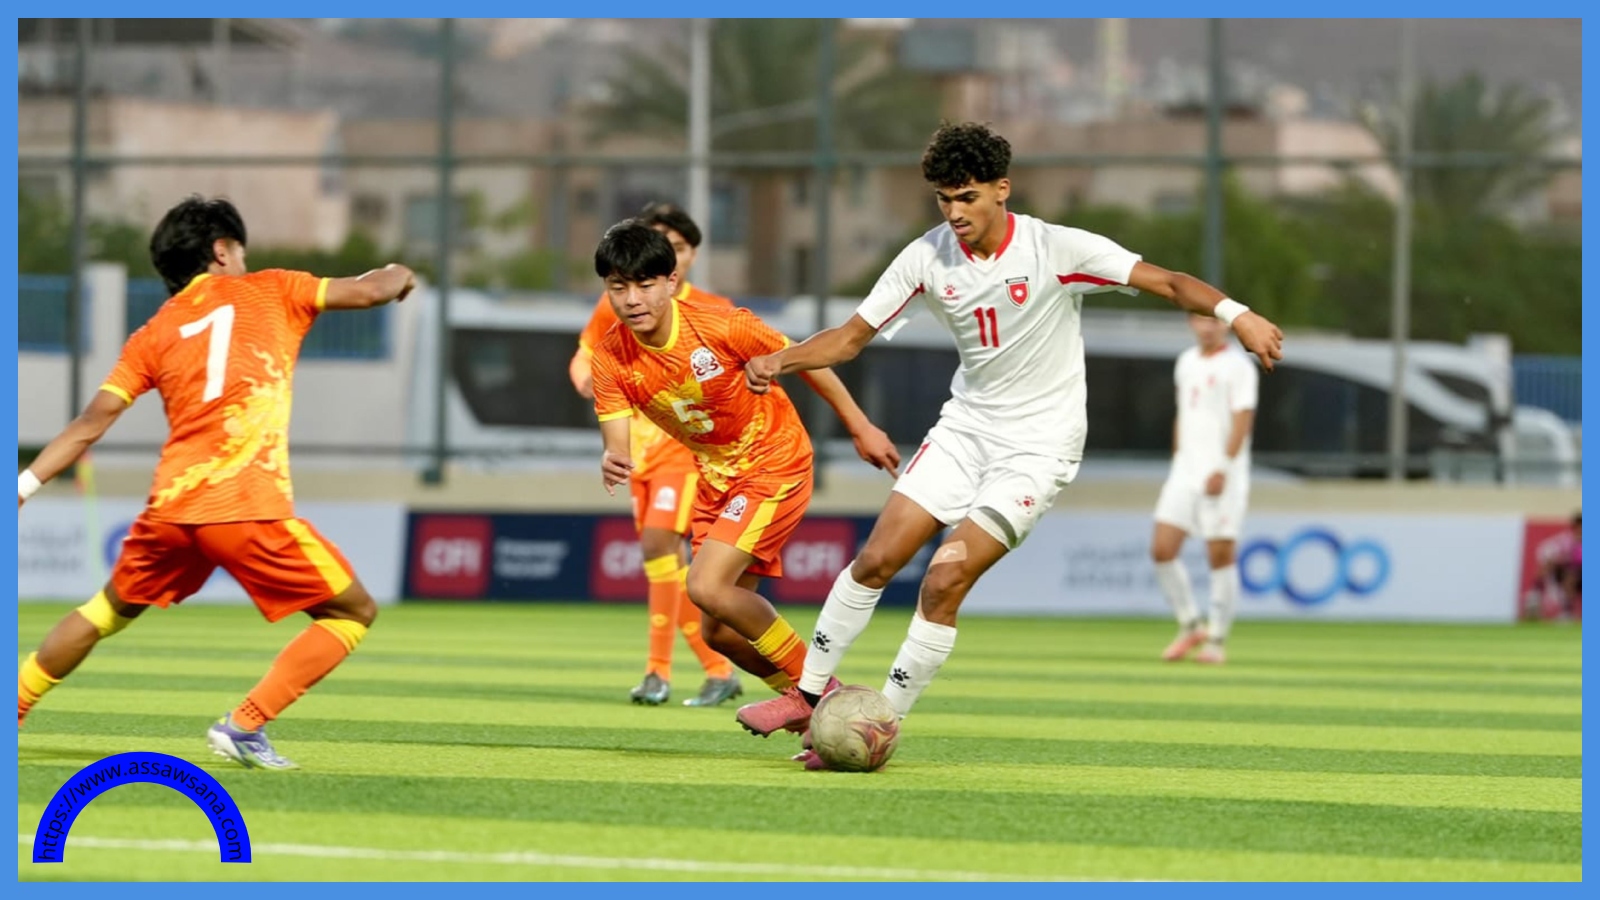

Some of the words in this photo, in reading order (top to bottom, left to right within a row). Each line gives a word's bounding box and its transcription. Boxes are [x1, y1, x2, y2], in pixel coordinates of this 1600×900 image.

[973, 307, 999, 348] 11
[671, 398, 714, 434] 5
[601, 539, 644, 579] CF
